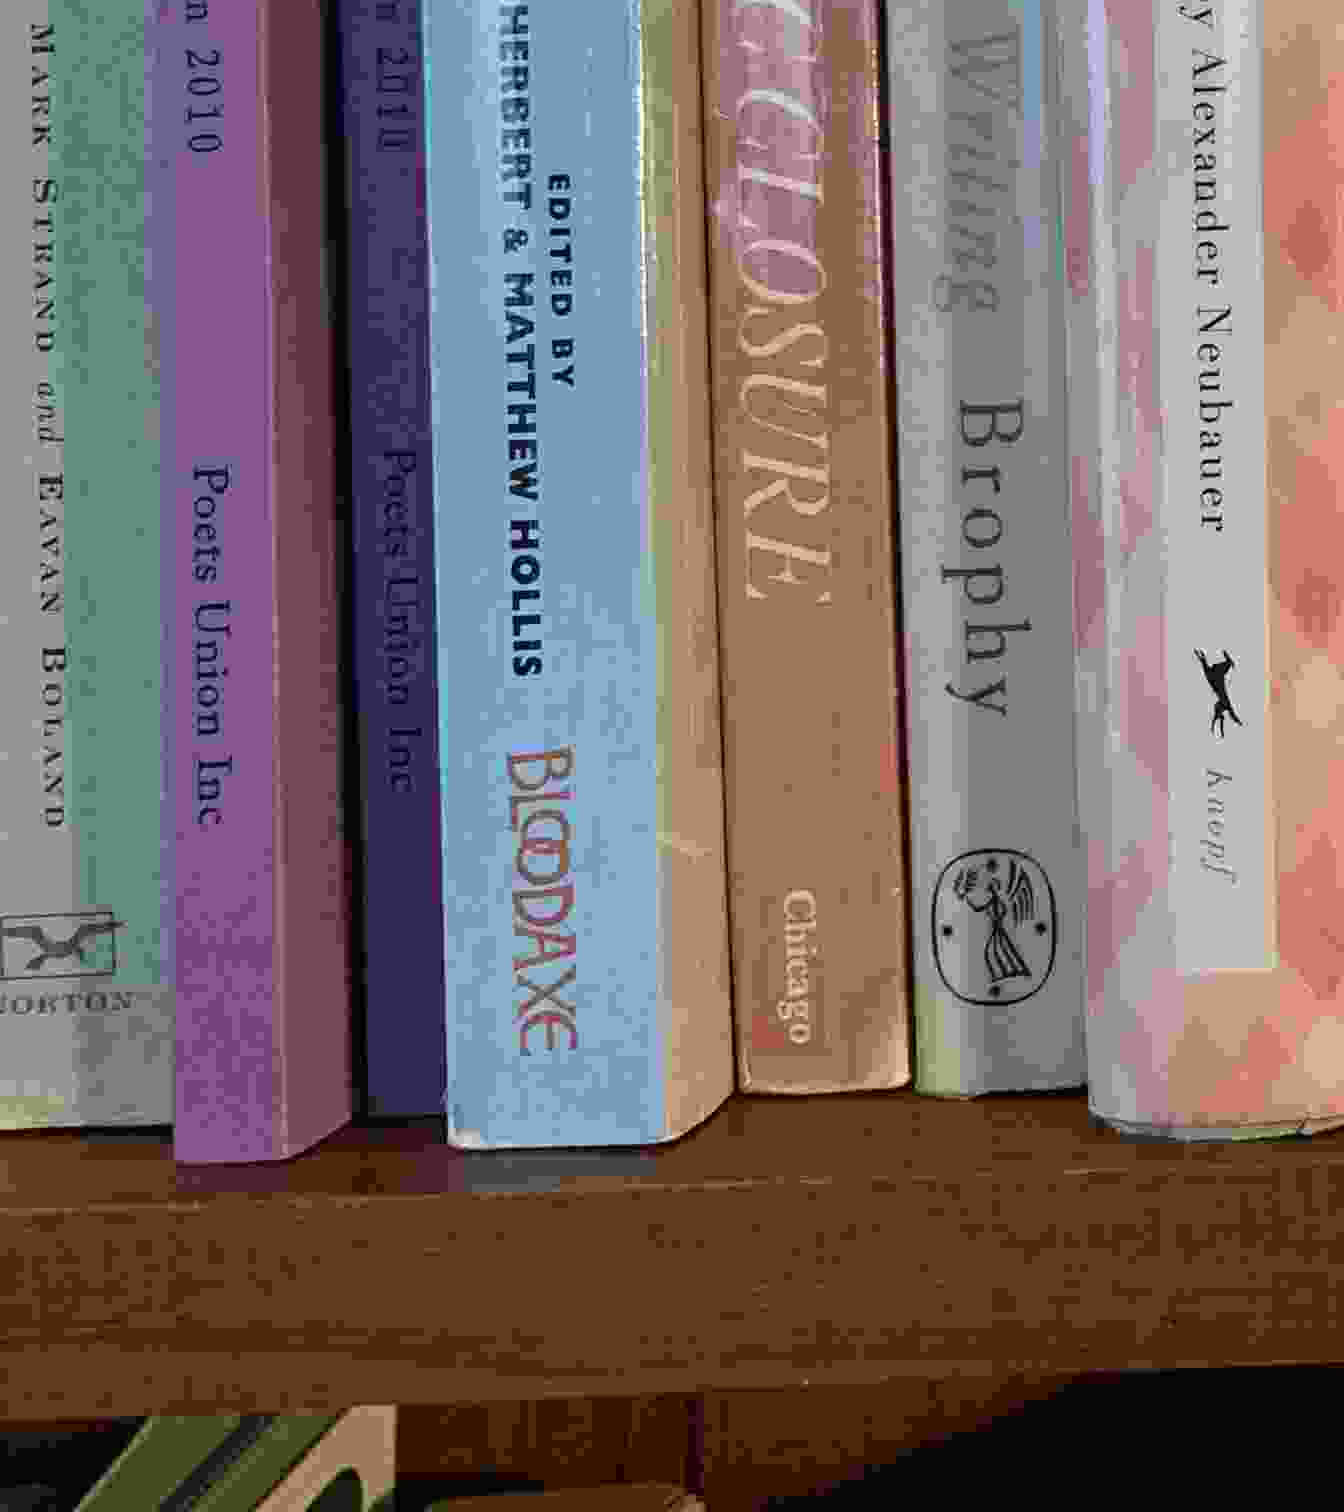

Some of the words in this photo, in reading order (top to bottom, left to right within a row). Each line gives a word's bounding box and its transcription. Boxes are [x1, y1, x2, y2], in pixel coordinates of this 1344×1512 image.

[30, 23, 57, 147] MARK
[184, 48, 224, 154] 2010
[500, 4, 532, 210] HERBERT
[503, 226, 529, 254] &
[932, 33, 1018, 312] Writing
[1192, 48, 1230, 285] Alexander
[32, 177, 59, 352] STRAND
[545, 172, 573, 318] EDITED
[36, 380, 64, 448] and
[503, 271, 538, 502] MATTHEW
[550, 338, 575, 388] BY
[734, 88, 832, 605] CLOSURE
[1196, 303, 1233, 531] Neubauer
[38, 471, 64, 614] EAVAN
[192, 463, 232, 584] Poets
[383, 449, 417, 560] Poets
[941, 401, 1032, 716] Brophy
[192, 599, 232, 738] Union
[384, 576, 419, 707] Union
[510, 518, 542, 678] HOLLIS
[40, 645, 66, 830] BOLAND
[197, 755, 234, 826] Inc
[505, 744, 578, 1056] BLOODAXE
[776, 890, 816, 1042] Chicago
